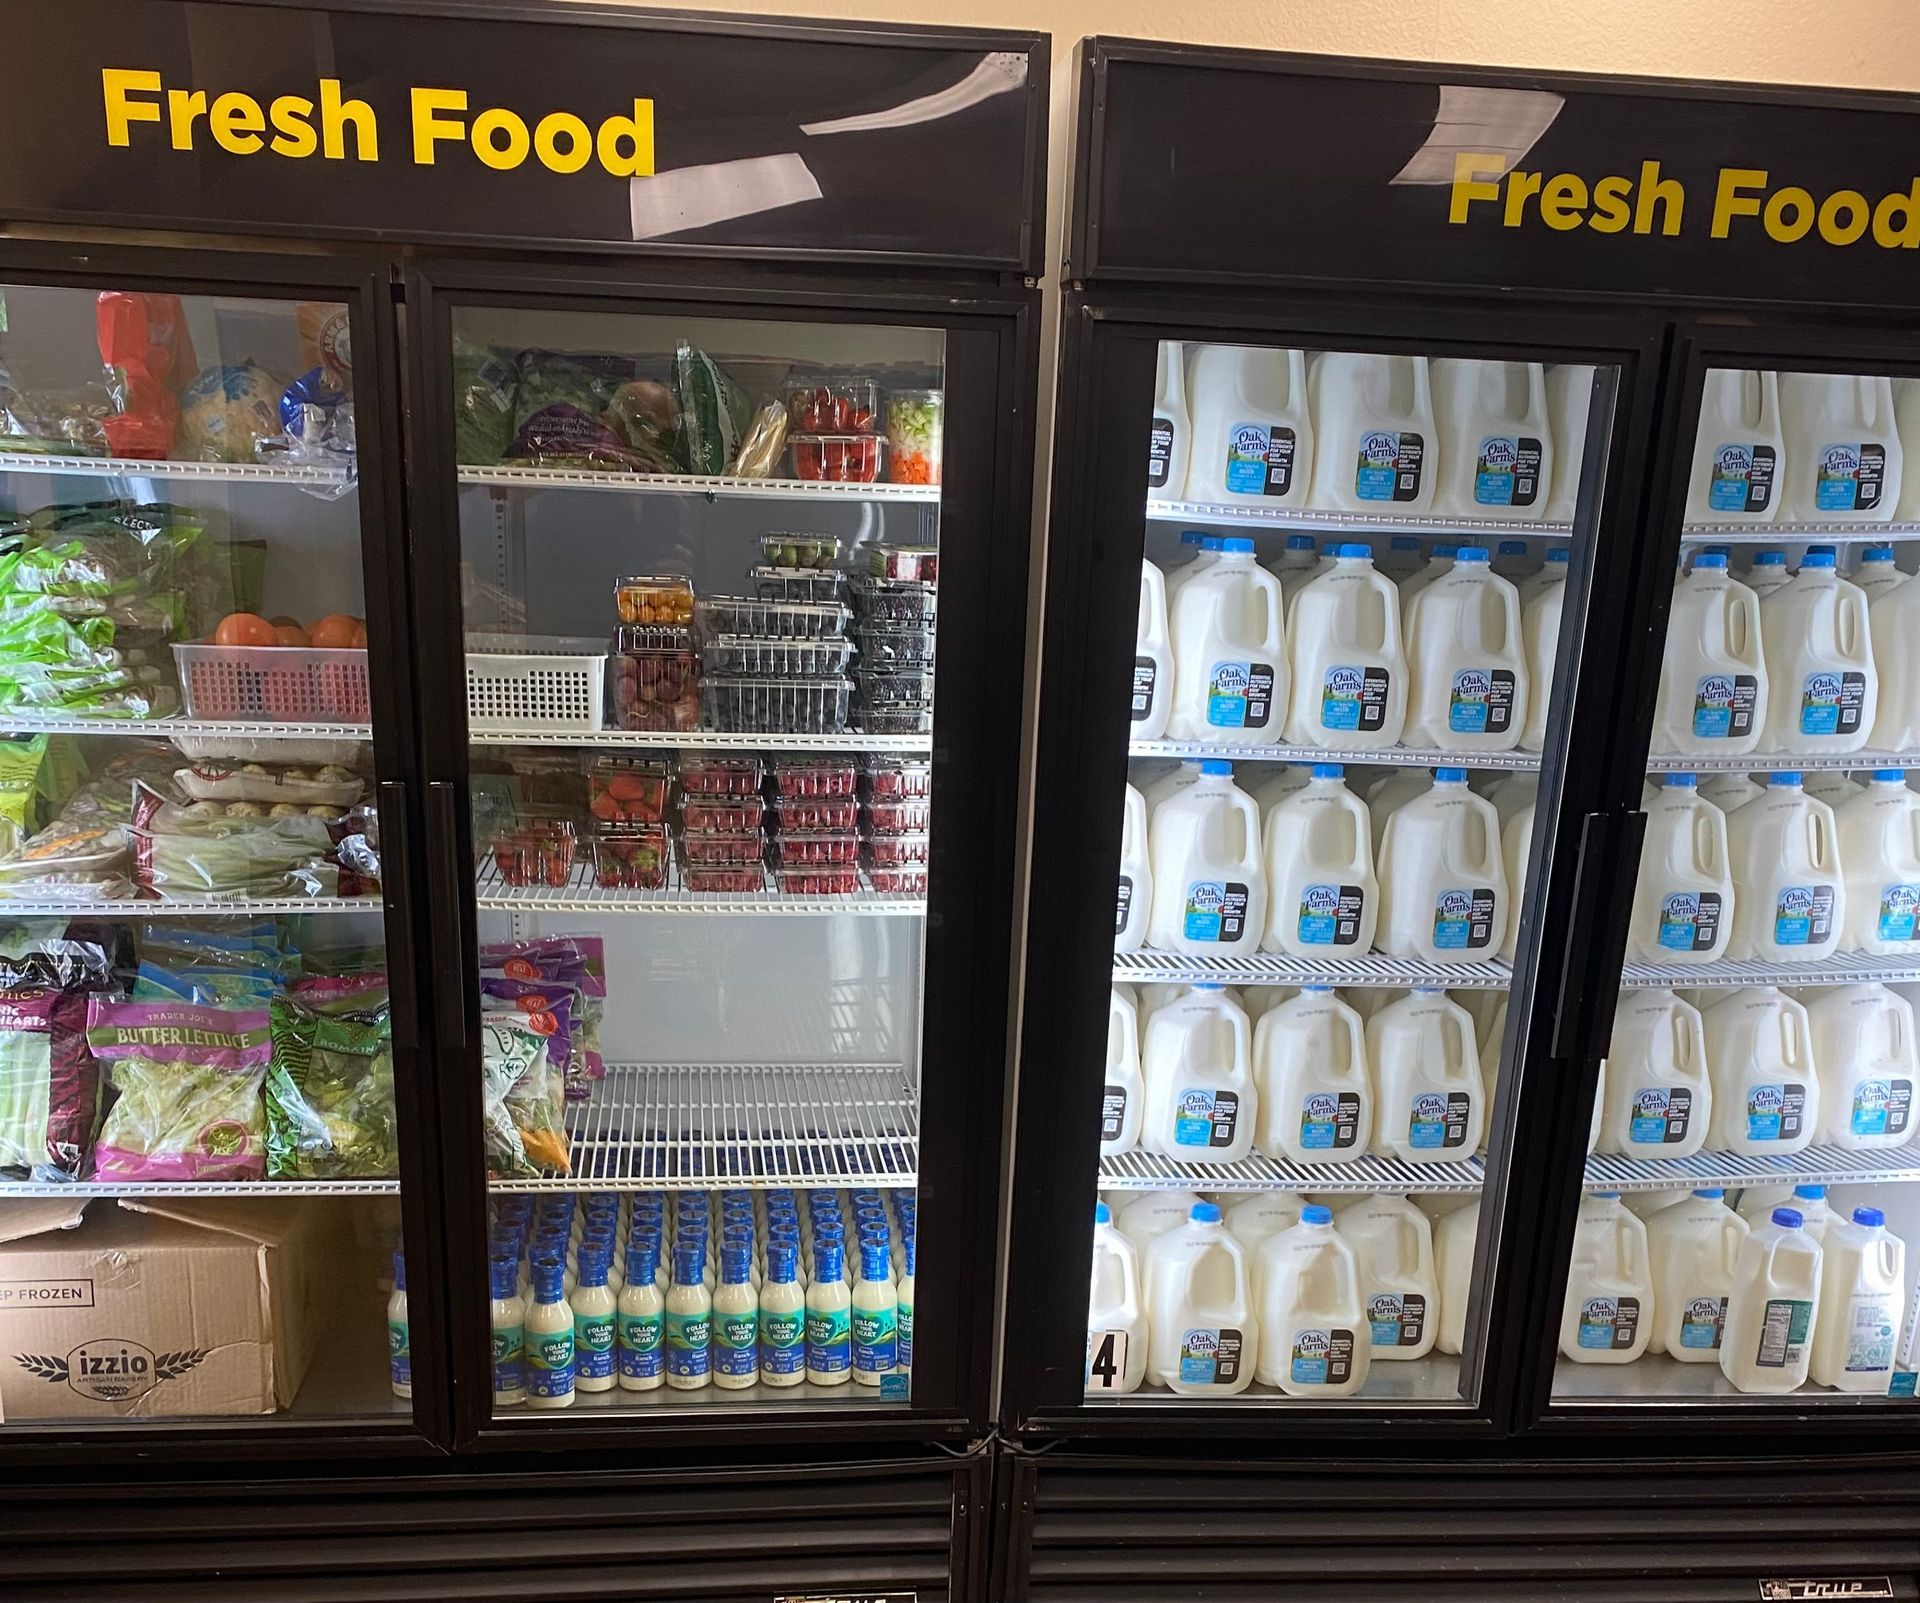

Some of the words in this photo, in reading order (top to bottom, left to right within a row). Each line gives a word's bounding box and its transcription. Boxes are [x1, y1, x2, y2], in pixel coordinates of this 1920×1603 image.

[102, 67, 378, 162] Fresh
[410, 87, 655, 177] Food
[1449, 152, 1685, 236] Fresh
[1710, 168, 1920, 248] Food
[1239, 430, 1262, 444] Oak
[1232, 441, 1267, 454] Farms
[1369, 438, 1392, 450] Oak
[1488, 443, 1511, 455] Oak
[1361, 448, 1396, 460] Farms
[1480, 453, 1514, 465] Farms
[1723, 450, 1745, 462] Oak
[1829, 451, 1851, 463] Oak
[1718, 460, 1750, 472] Farms
[1824, 461, 1857, 474] Farms
[1220, 668, 1242, 680] Oak
[1334, 670, 1357, 682] Oak
[1462, 672, 1485, 684] Oak
[1214, 679, 1247, 689] Farms
[1326, 680, 1361, 692] Farms
[1455, 682, 1488, 694] Farms
[1706, 681, 1728, 692] Oak
[1814, 680, 1835, 690] Oak
[1699, 691, 1732, 702] Farms
[1806, 688, 1839, 700] Farms
[1196, 887, 1218, 898] Oak
[1310, 890, 1332, 901] Oak
[1786, 892, 1806, 902] Oak
[1188, 896, 1222, 906] Farms
[1303, 899, 1336, 910] Farms
[1444, 894, 1466, 906] Oak
[1671, 898, 1692, 910] Oak
[1780, 900, 1810, 910] Farms
[1437, 904, 1470, 915] Farms
[1664, 908, 1696, 918] Farms
[147, 1012, 185, 1021] TRADER
[117, 1028, 182, 1046] BUTTER
[184, 1030, 250, 1049] LETTUCE
[1186, 1095, 1208, 1106] Oak
[1642, 1094, 1664, 1104] Oak
[1756, 1090, 1777, 1101] Oak
[1311, 1097, 1332, 1108] Oak
[1420, 1098, 1442, 1109] Oak
[1634, 1103, 1667, 1112] Farms
[1748, 1099, 1781, 1109] Farms
[1179, 1104, 1212, 1113] Farms
[1304, 1107, 1336, 1117] Farms
[1412, 1107, 1445, 1116] Farms
[19, 1288, 82, 1300] FROZEN
[1376, 1299, 1397, 1310] Oak
[1590, 1302, 1612, 1312] Oak
[1693, 1302, 1714, 1312] Oak
[1583, 1310, 1615, 1318] Farms
[588, 1325, 613, 1334] FOLLOW
[630, 1325, 657, 1334] FOLLOW
[686, 1322, 710, 1332] FOLLOW
[728, 1322, 754, 1331] FOLLOW
[770, 1322, 796, 1330] FOLLOW
[590, 1334, 612, 1344] HEART
[633, 1336, 655, 1344] HEART
[690, 1333, 708, 1342] HEART
[1190, 1334, 1212, 1346] Oak
[1302, 1334, 1324, 1346] Oak
[544, 1342, 570, 1352] FOLLOW
[1184, 1344, 1216, 1353] Farms
[1296, 1344, 1328, 1353] Farms
[548, 1352, 568, 1361] HEART
[1092, 1334, 1117, 1387] 4
[80, 1350, 148, 1375] izzio
